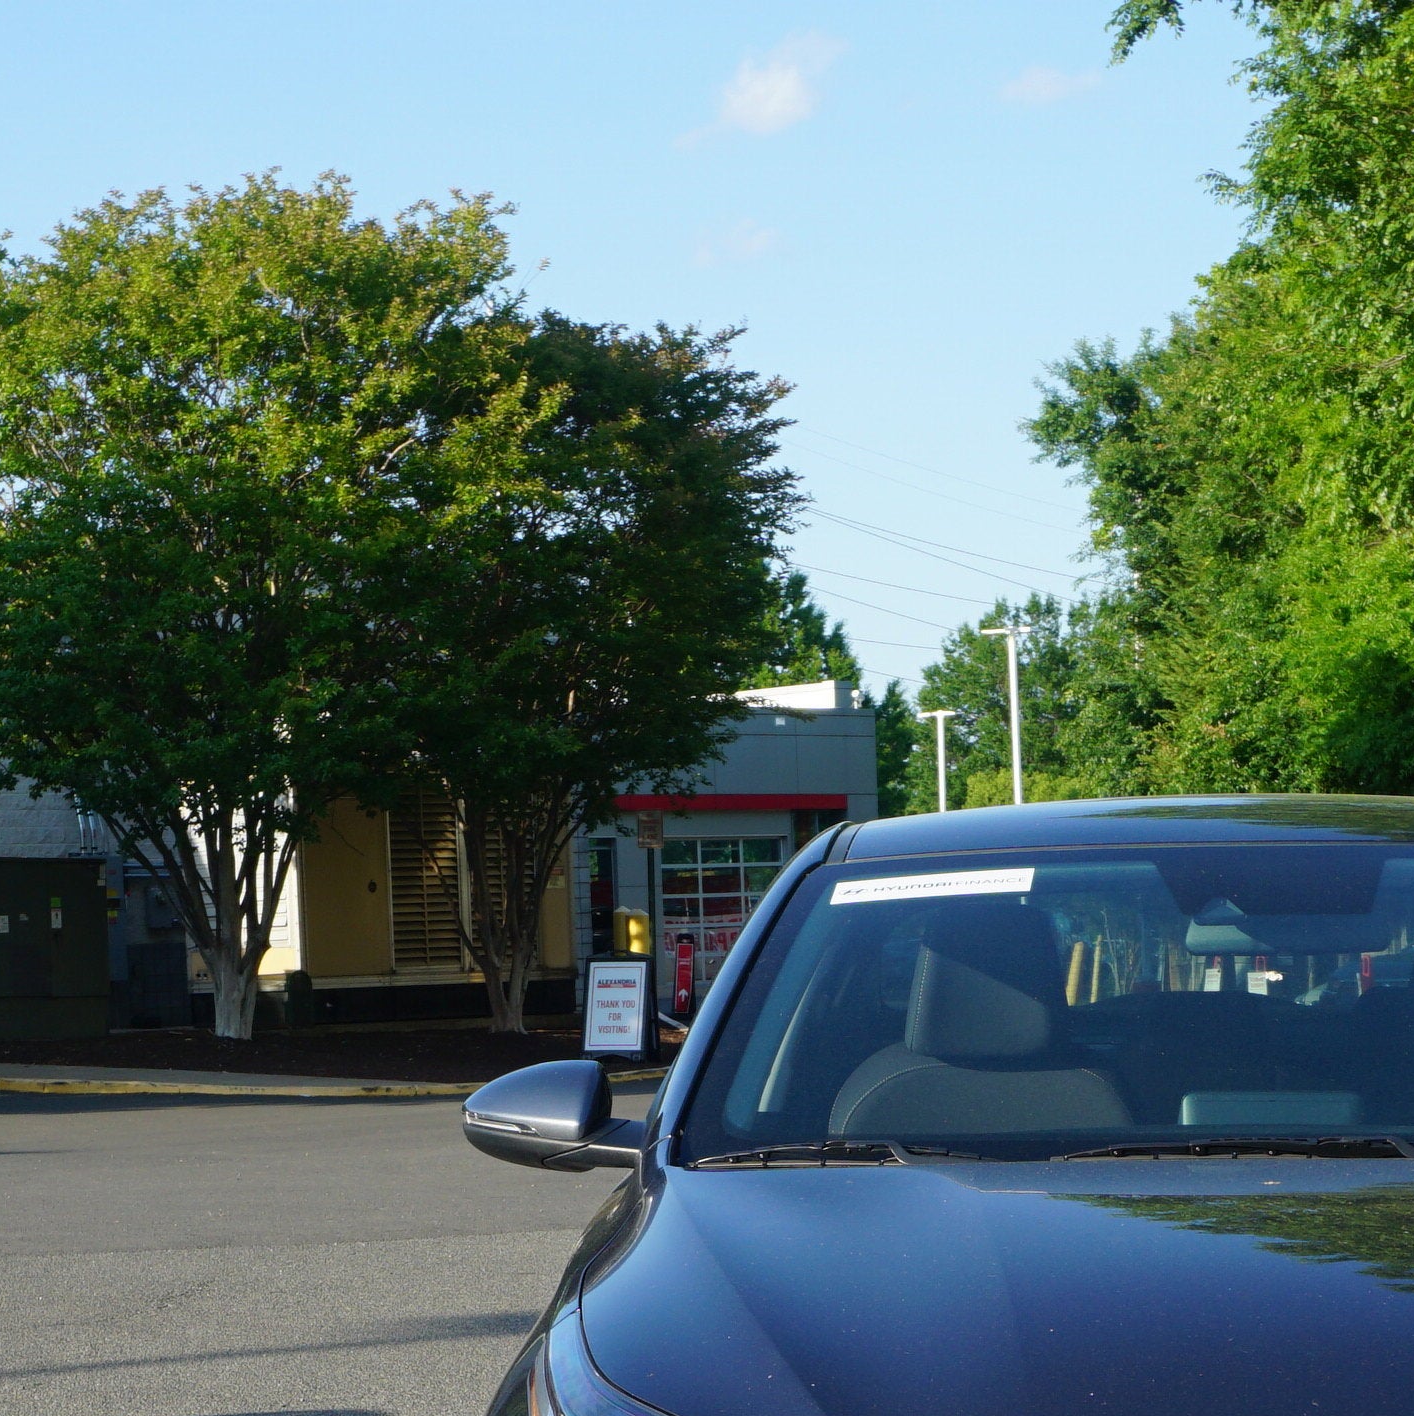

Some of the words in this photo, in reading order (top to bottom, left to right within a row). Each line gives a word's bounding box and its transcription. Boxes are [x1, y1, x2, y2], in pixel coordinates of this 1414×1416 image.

[873, 881, 952, 892] HYUNDAI
[955, 875, 1027, 886] FINANCE
[596, 1000, 620, 1009] THANK
[621, 1000, 636, 1009] YOU
[607, 1012, 622, 1021] FOR
[597, 1025, 631, 1034] VISITING!
